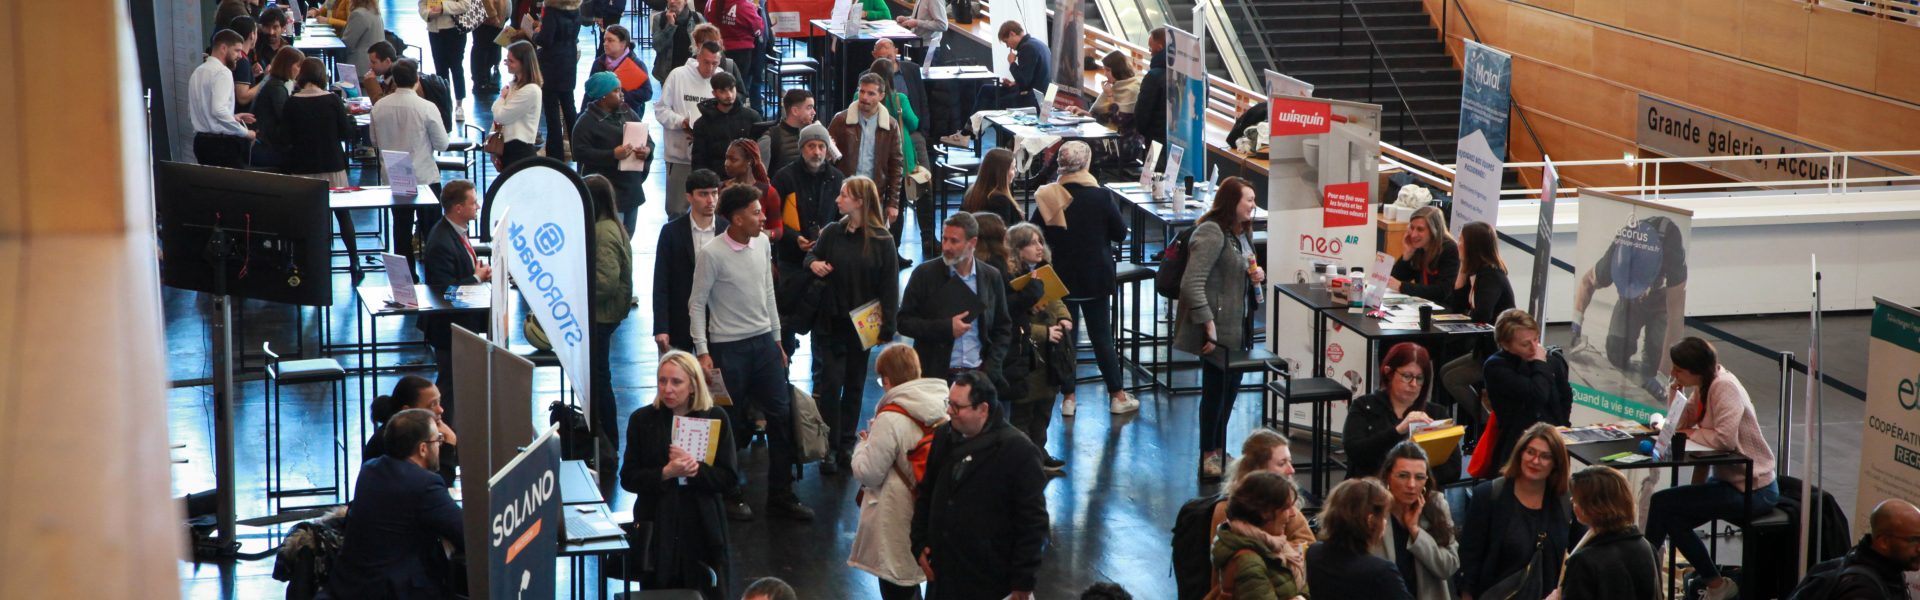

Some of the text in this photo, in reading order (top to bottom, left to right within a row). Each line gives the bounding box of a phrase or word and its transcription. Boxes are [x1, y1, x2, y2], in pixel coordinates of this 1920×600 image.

[727, 4, 737, 18] A
[1475, 62, 1501, 91] Matal
[1279, 109, 1325, 128] wirquin
[1648, 106, 1700, 144] Grande
[1708, 130, 1769, 171] galerie,
[1300, 234, 1359, 254] neo AIR
[1616, 229, 1648, 242] acorus
[1572, 388, 1650, 421] Quand la vie se rén
[493, 470, 554, 547] SOLANO
